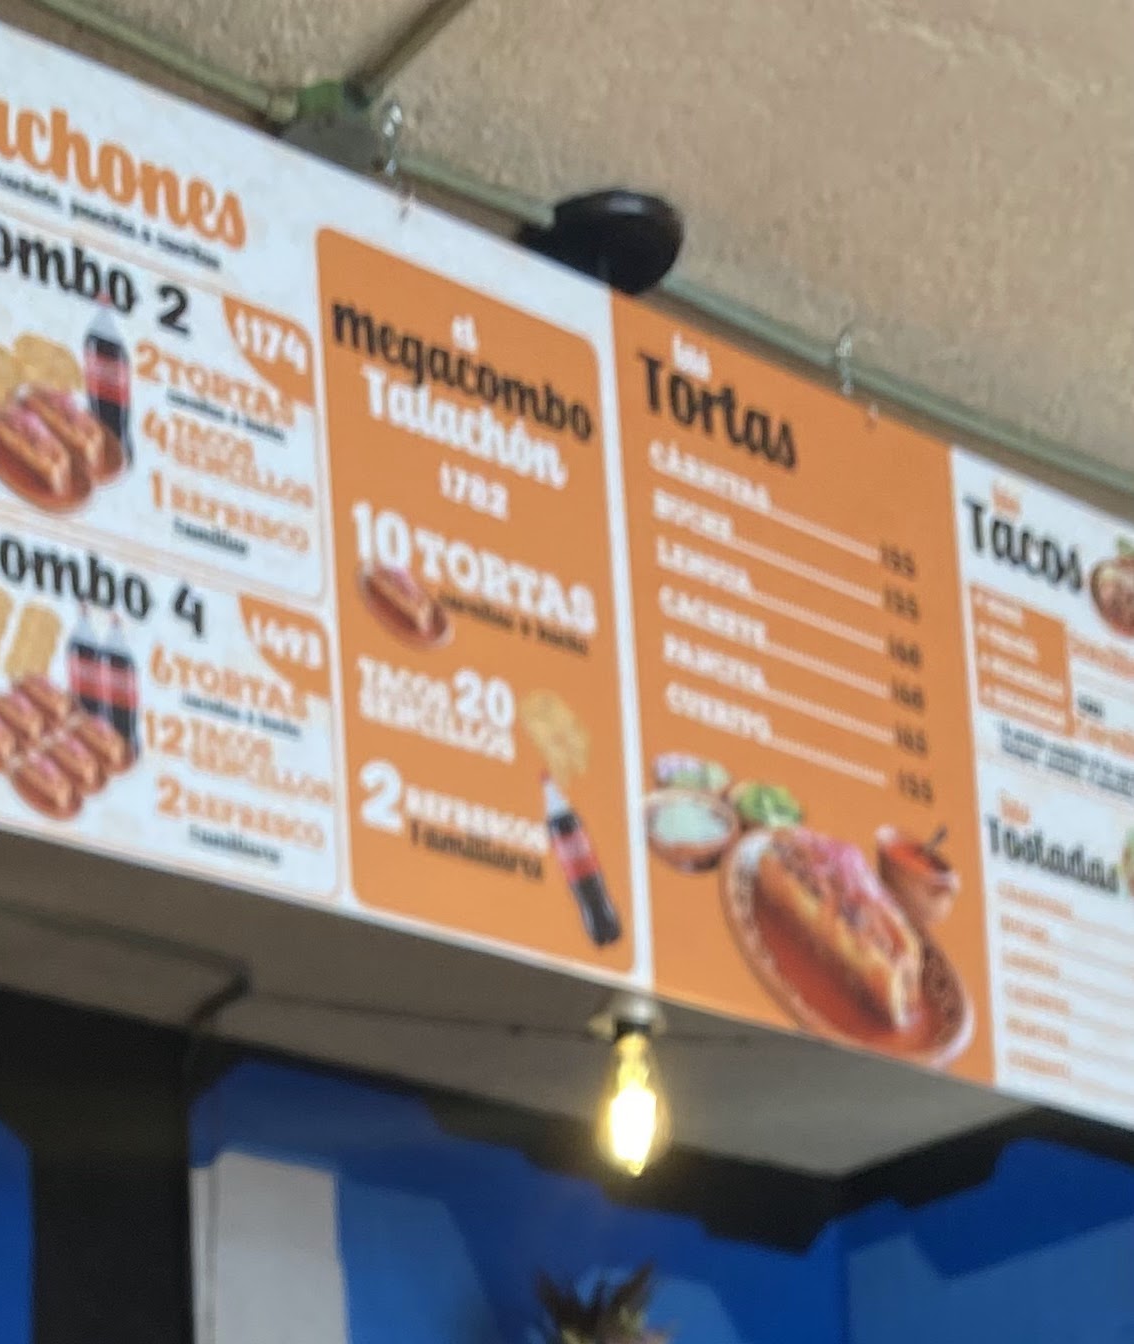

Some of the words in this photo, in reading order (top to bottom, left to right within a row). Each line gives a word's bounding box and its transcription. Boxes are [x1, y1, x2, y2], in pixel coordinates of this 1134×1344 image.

[158, 284, 191, 337] 2
[361, 361, 569, 491] Talachón
[636, 348, 799, 473] Tortas
[351, 500, 412, 570] 10
[414, 526, 599, 635] TORTAS
[962, 492, 1084, 595] Tacos
[172, 582, 206, 640] 4
[452, 667, 516, 730] 20
[358, 757, 405, 836] 2
